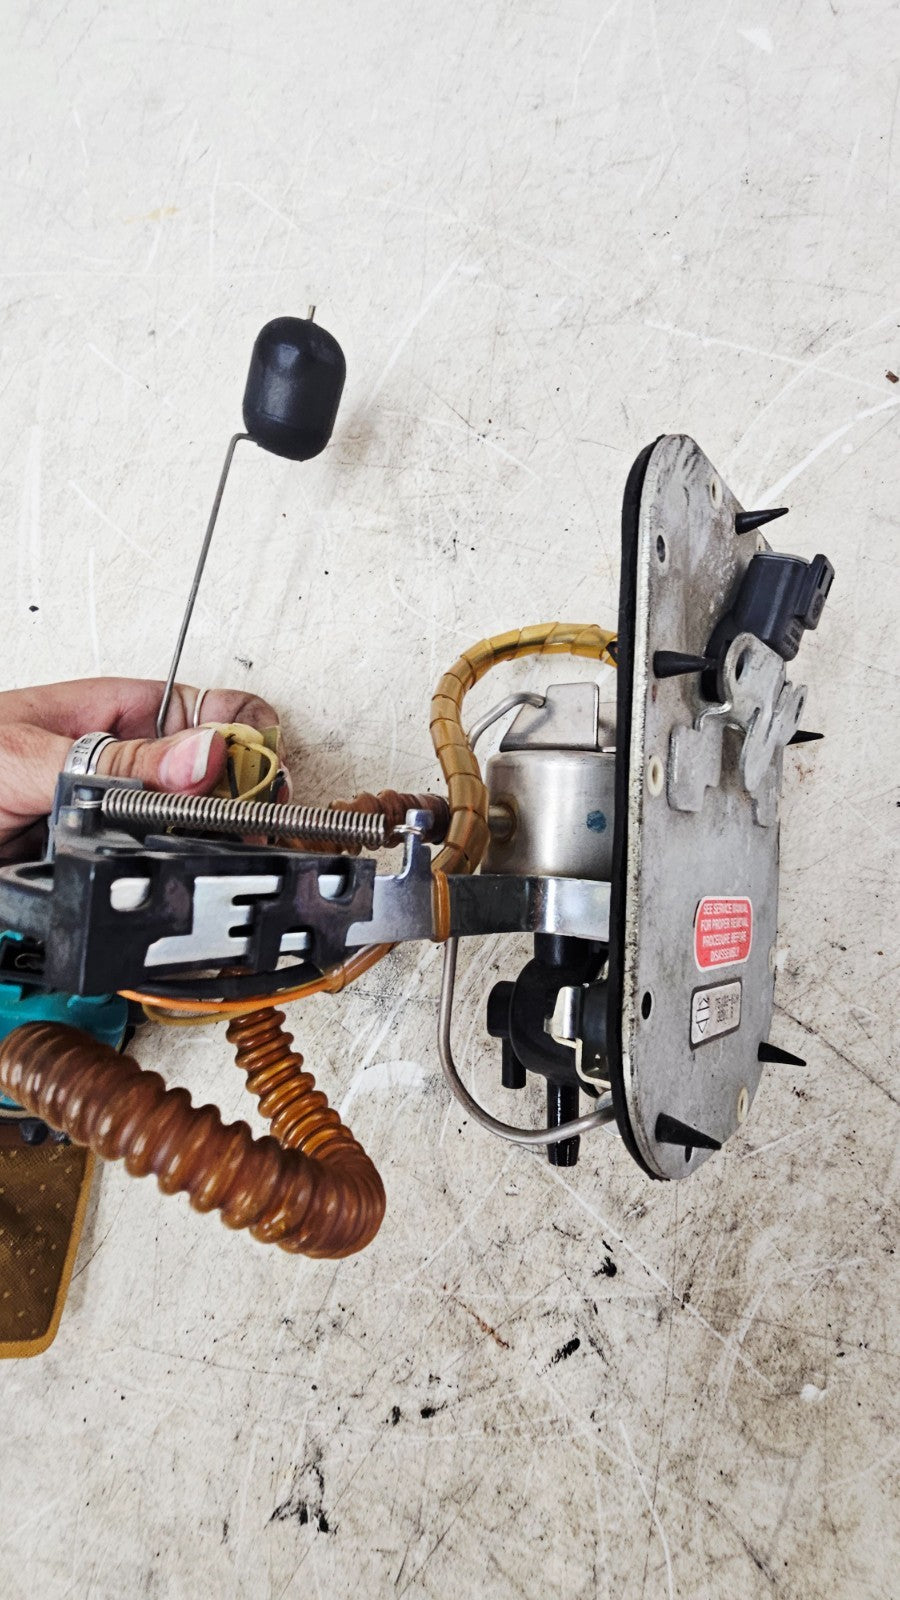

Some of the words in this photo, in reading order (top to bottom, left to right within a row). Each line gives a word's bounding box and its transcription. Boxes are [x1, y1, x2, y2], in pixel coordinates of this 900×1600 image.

[703, 903, 713, 915] SEE
[713, 903, 733, 914] SERVICE
[701, 919, 711, 931] FOR
[712, 918, 730, 930] PROPER
[703, 933, 730, 947] PROCEDURE
[730, 931, 747, 943] BEFORE
